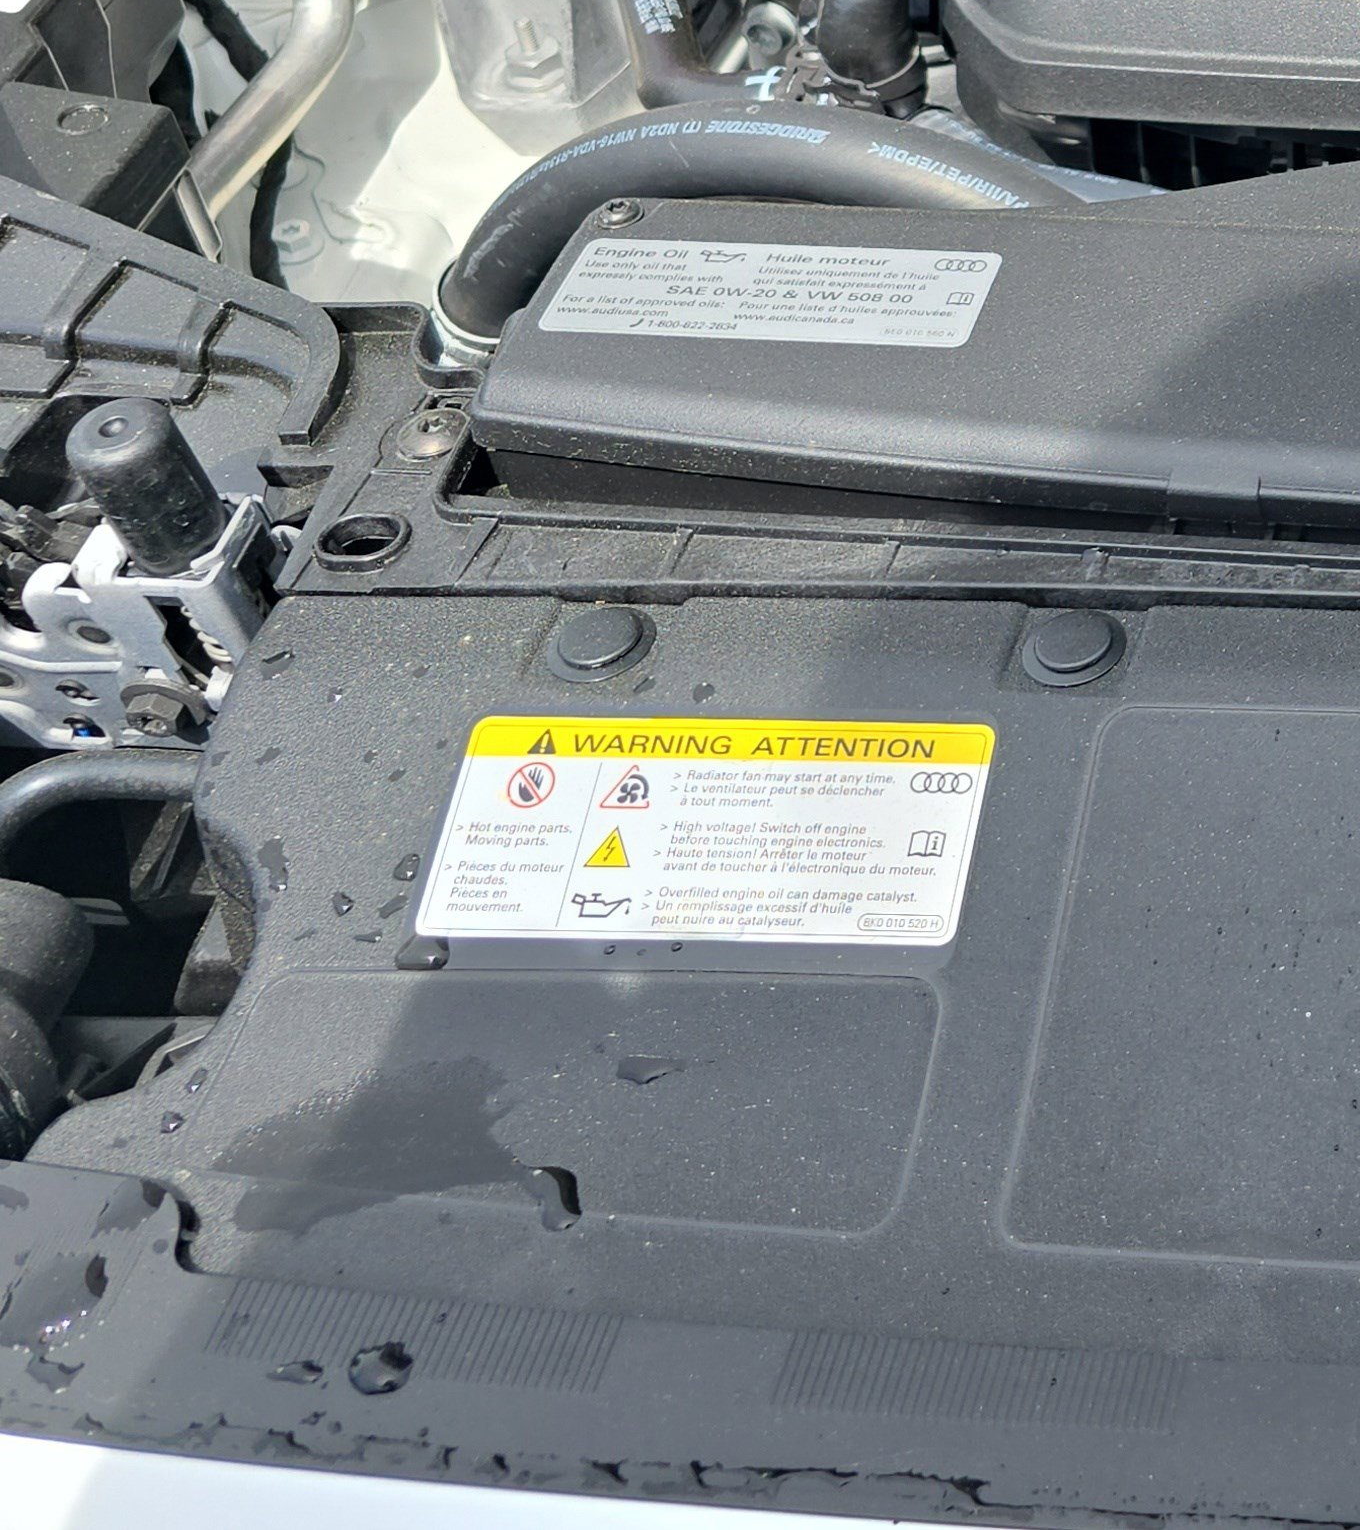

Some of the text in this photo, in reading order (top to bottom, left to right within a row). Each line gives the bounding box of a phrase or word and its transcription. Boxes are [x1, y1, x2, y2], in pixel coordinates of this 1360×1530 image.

[705, 120, 831, 144] BRIDGESTONE
[594, 246, 689, 259] Engine Oil
[585, 260, 687, 271] Use only oil that
[766, 253, 891, 266] Huile moteur
[579, 271, 723, 283] expressly complies with
[806, 269, 880, 280] uniquement
[884, 271, 898, 279] de
[753, 278, 774, 286] qui
[777, 278, 824, 287] satisfait
[666, 285, 913, 303] SAE 0W-20 & VW 508 00
[562, 294, 584, 303] For
[598, 295, 617, 304] list
[620, 296, 634, 304] of
[635, 298, 695, 308] approved
[739, 301, 770, 310] Pour
[772, 303, 795, 311] une
[800, 304, 826, 312] liste
[557, 306, 669, 317] www.audiusa.com
[734, 314, 855, 325] www.audicanada.ca
[574, 734, 935, 758] WARNING ATTENTION
[687, 770, 895, 786] Radiator fan may start at any time.
[684, 783, 884, 796] Le ventilateur peut se déclencher
[680, 796, 773, 807] à tout moment.
[469, 823, 490, 833] Hot
[494, 824, 536, 836] engine
[674, 822, 866, 836] High voltage! Switch off engine
[465, 836, 549, 848] Moving parts.
[671, 835, 886, 849] before touching engine electronics.
[666, 848, 867, 861] Haute tension! Arrêter le moteur
[458, 860, 564, 873] Pièces du moteur
[663, 861, 697, 871] avant
[701, 861, 716, 871] de
[720, 862, 767, 872] toucher
[770, 861, 778, 872] à
[870, 864, 885, 875] du
[889, 866, 936, 876] moteur.
[453, 875, 507, 885] chaudes.
[450, 887, 507, 898] Pièces en
[659, 887, 917, 903] Overfilled engine oil can damage catalyst.
[446, 902, 523, 912] mouvement.
[656, 901, 852, 914] Un remplissage excessif d'huile
[651, 915, 805, 928] peut nuire au catalyseur.
[885, 918, 906, 928] 010
[909, 918, 928, 928] 520
[931, 919, 939, 928] H
